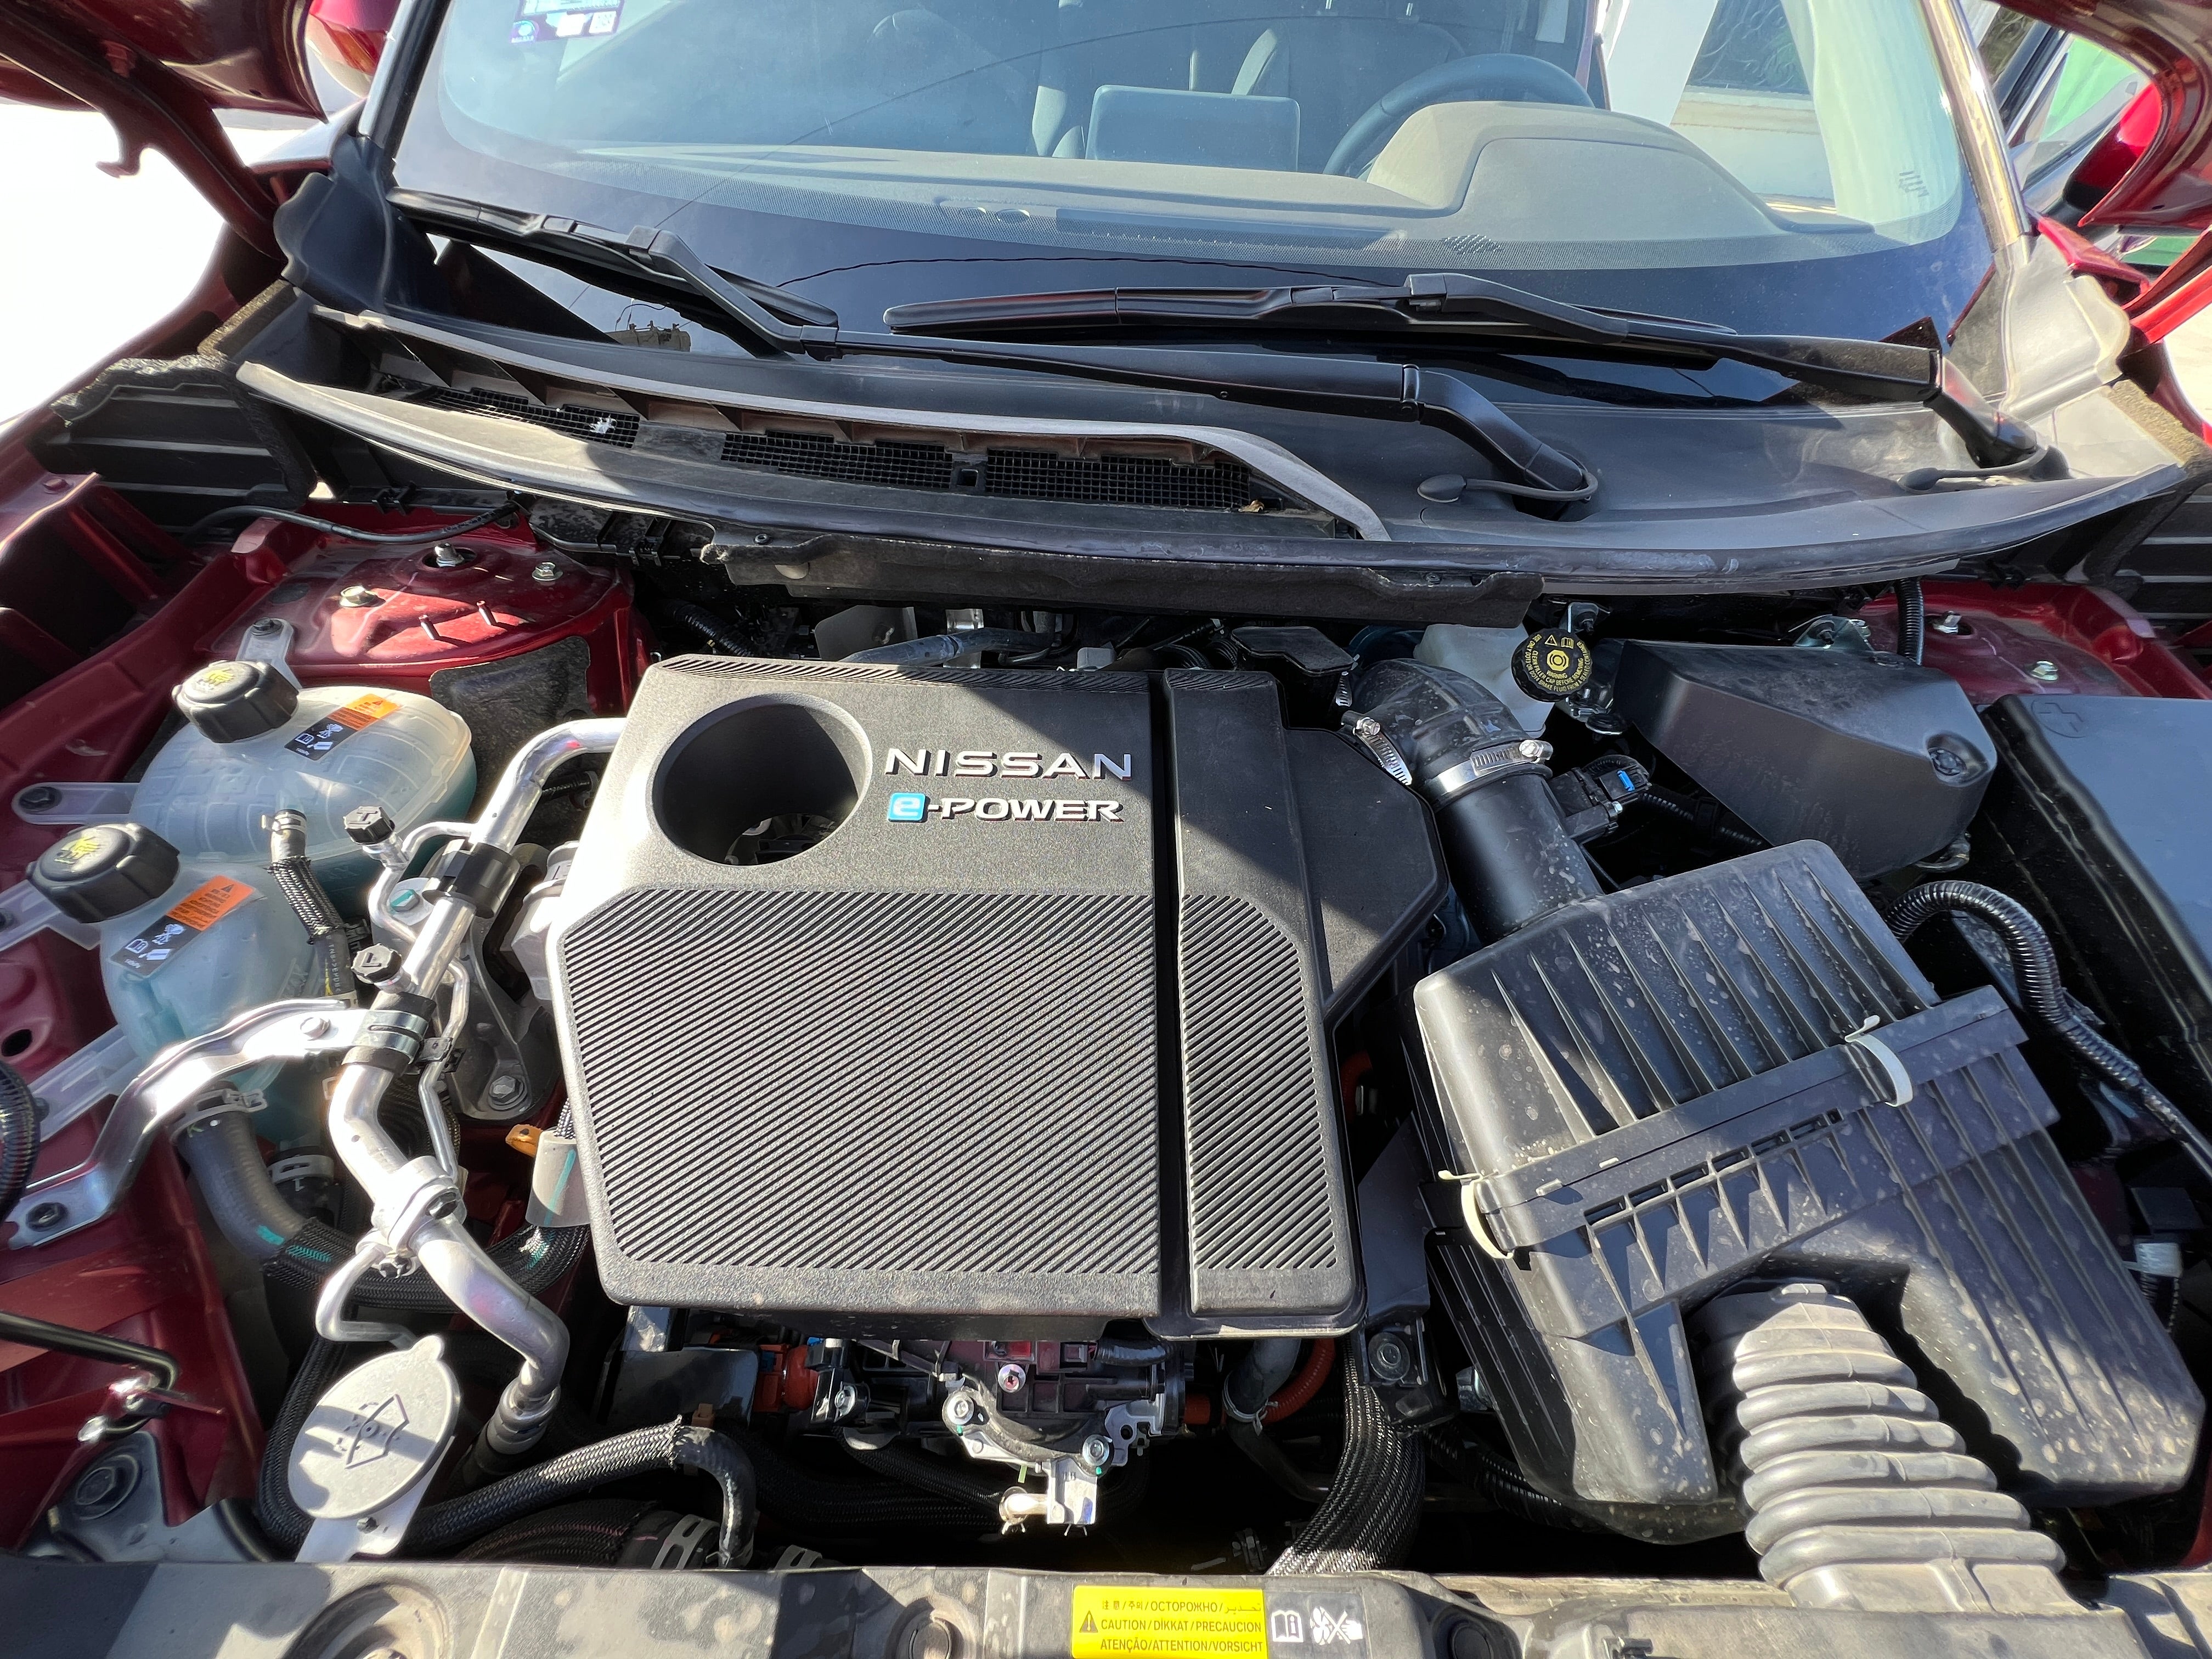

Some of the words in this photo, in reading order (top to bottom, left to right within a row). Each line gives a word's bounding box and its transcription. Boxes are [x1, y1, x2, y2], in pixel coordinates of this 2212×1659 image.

[1538, 680, 1553, 690] BRAKE
[1555, 677, 1574, 685] BEFORE
[884, 748, 1132, 780] NISSAN
[888, 793, 1124, 822] e-POWER
